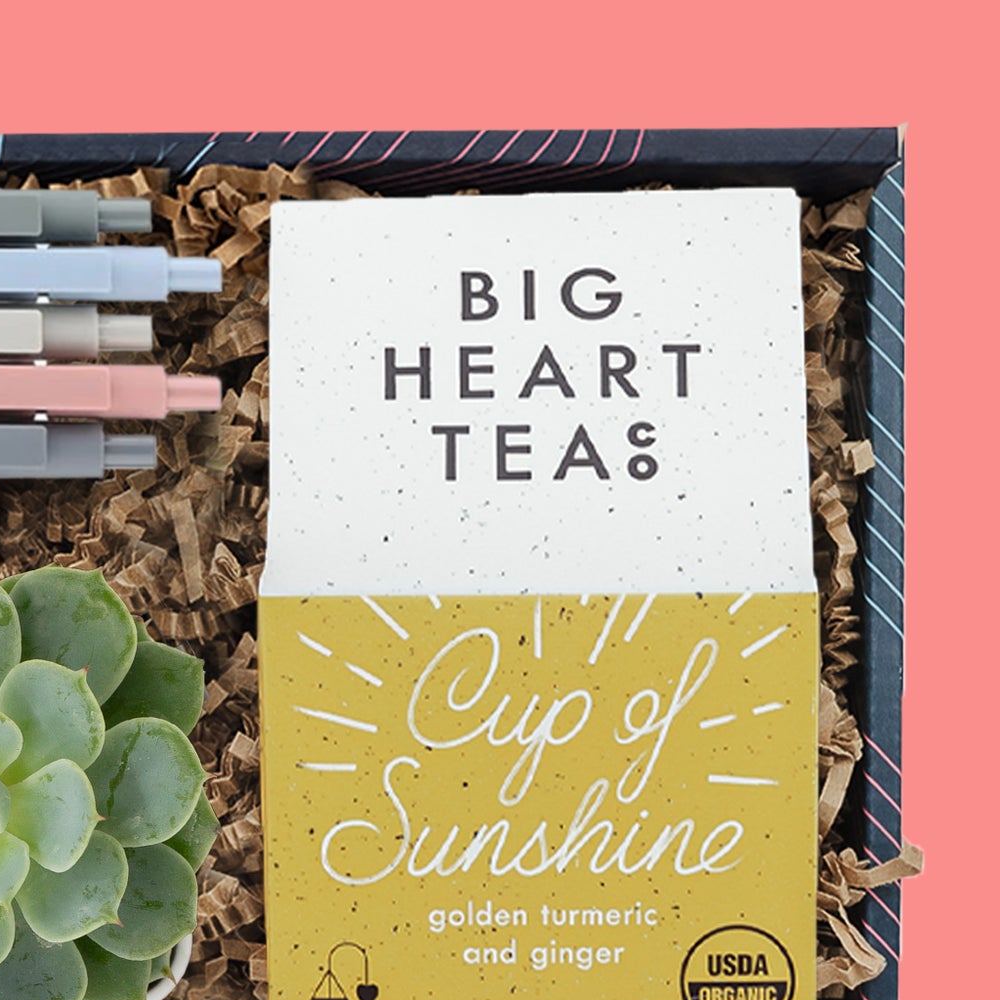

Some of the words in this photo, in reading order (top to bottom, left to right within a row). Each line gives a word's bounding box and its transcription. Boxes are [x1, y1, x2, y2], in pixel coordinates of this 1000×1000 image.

[460, 267, 623, 321] BIG
[384, 344, 701, 400] HEART
[431, 424, 611, 481] TEA
[408, 627, 593, 805] Cup
[613, 638, 718, 802] of
[321, 755, 744, 885] Sunshine
[428, 902, 529, 933] golden
[541, 902, 658, 927] turmeric
[463, 939, 517, 965] and
[530, 939, 625, 970] ginger
[707, 952, 770, 977] USDA
